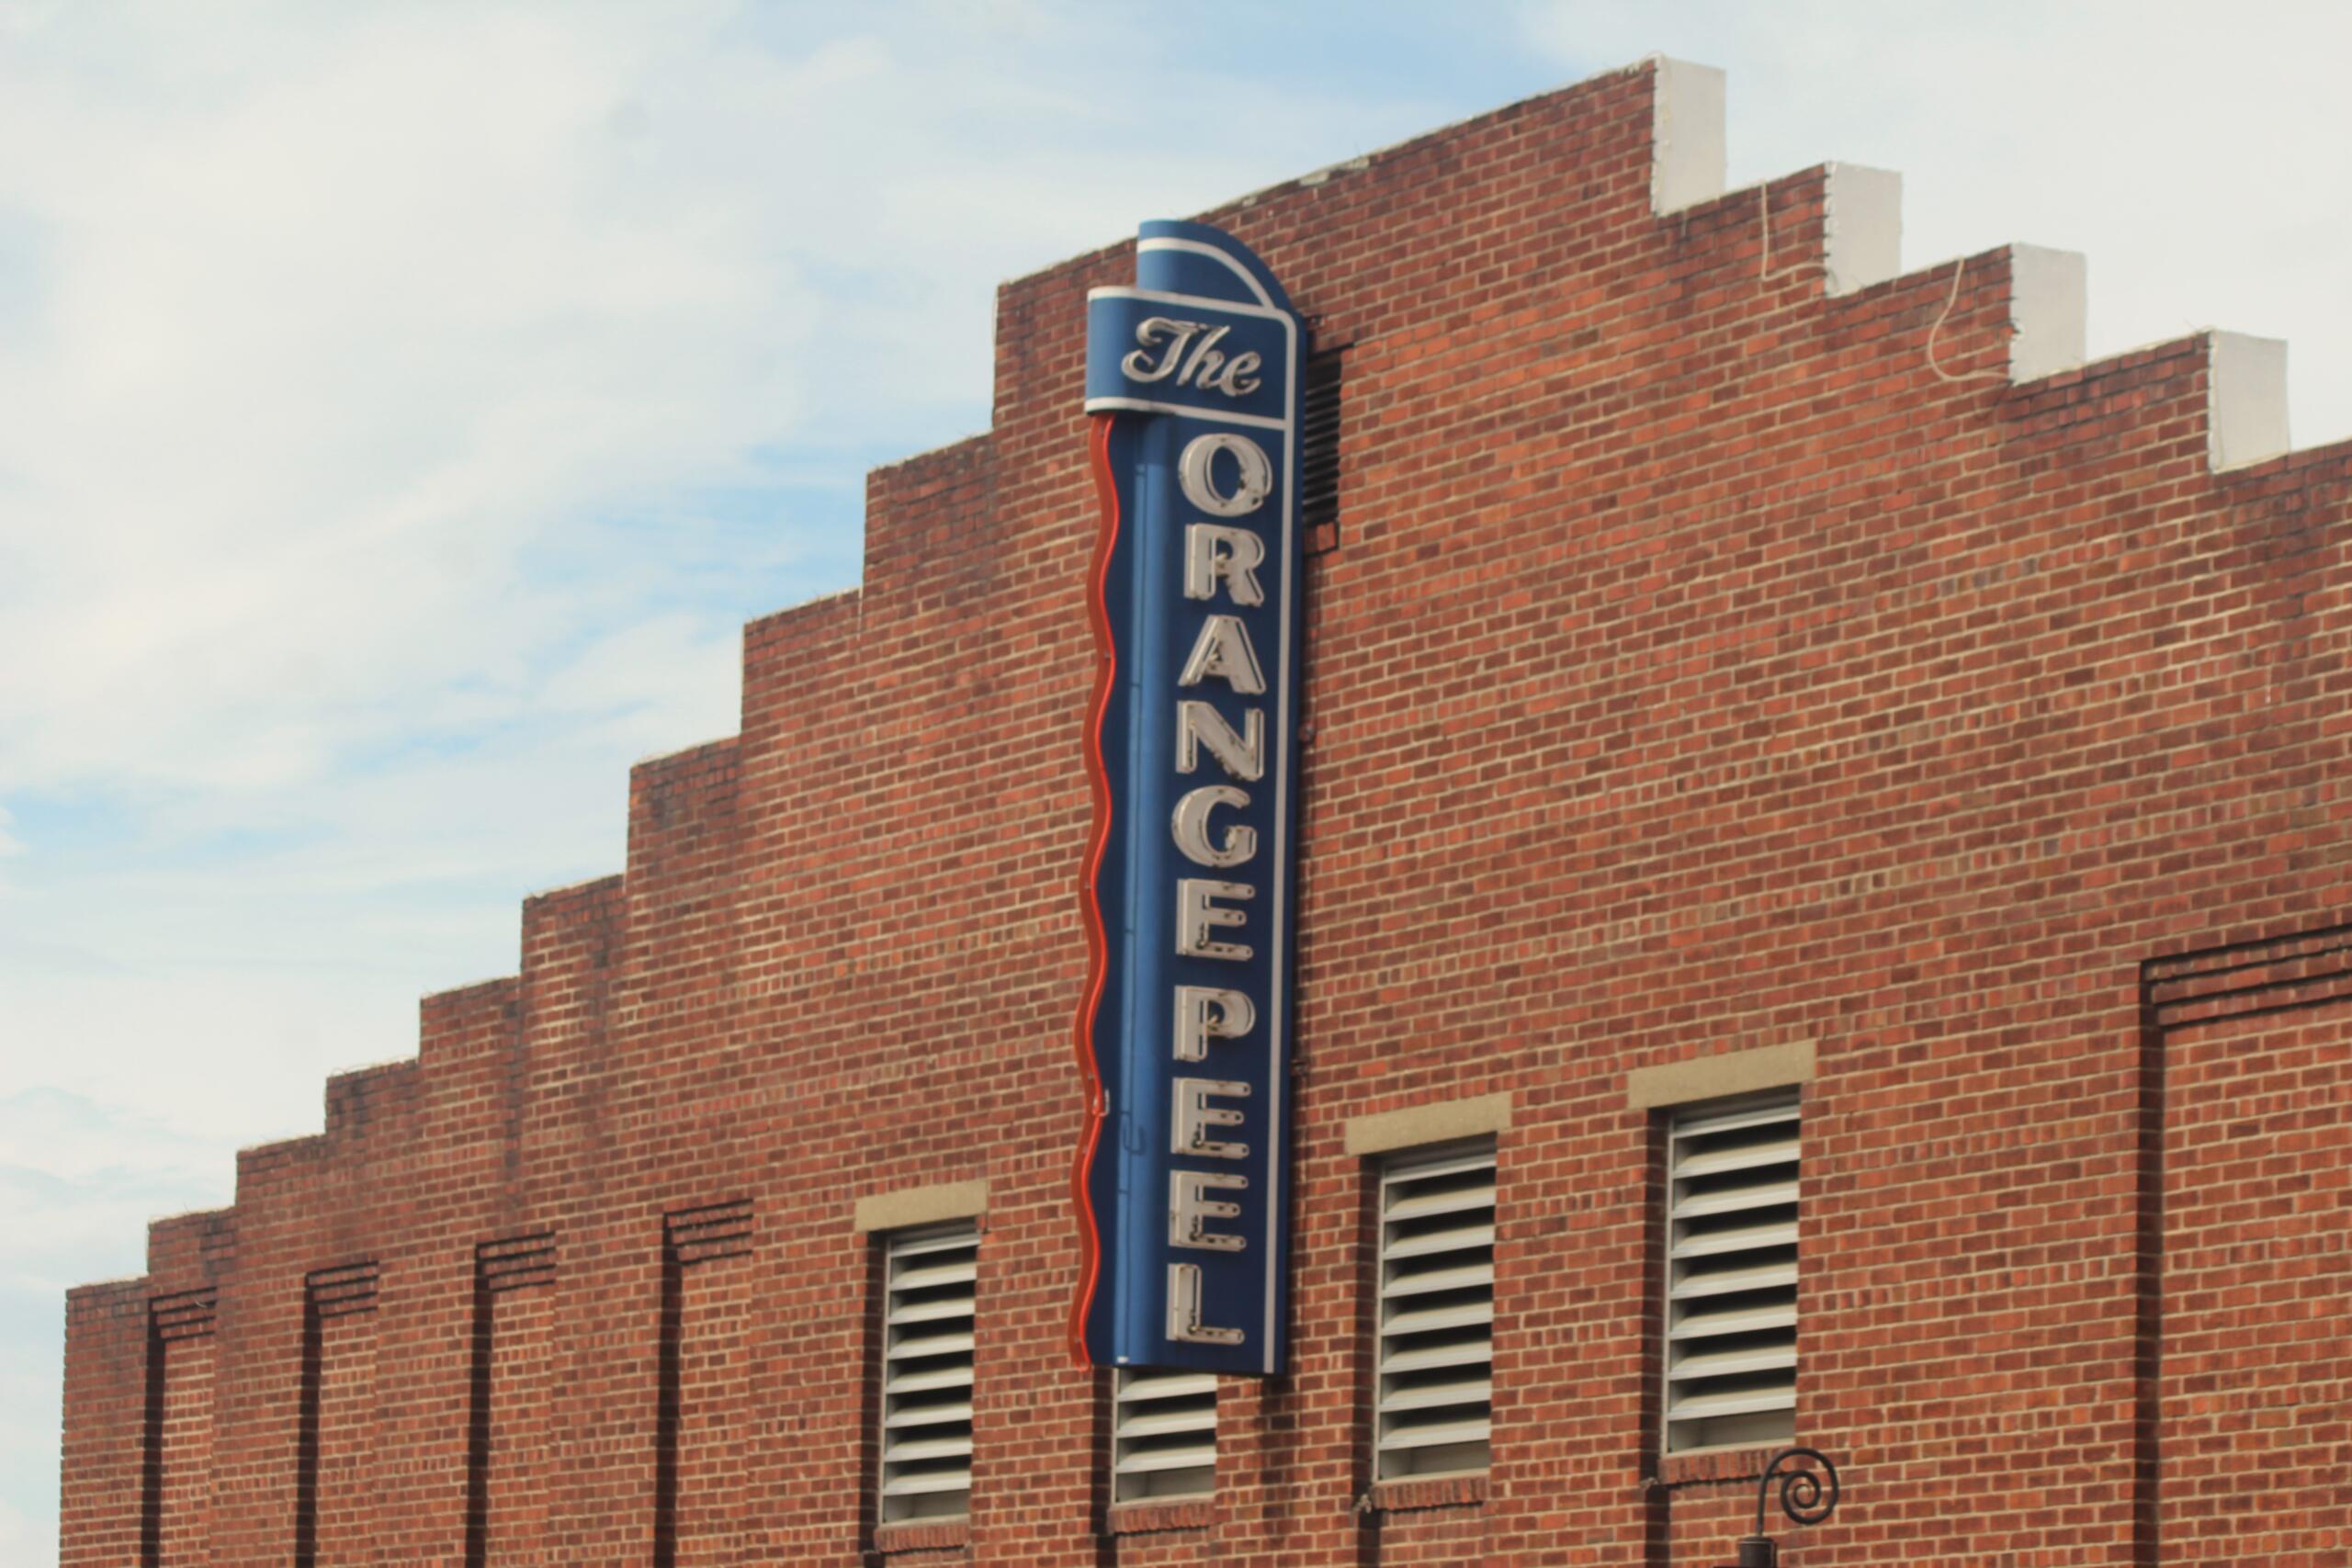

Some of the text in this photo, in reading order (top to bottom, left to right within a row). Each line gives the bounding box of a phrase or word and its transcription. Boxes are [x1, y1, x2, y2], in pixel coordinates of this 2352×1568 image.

[1121, 316, 1261, 397] The
[1165, 433, 1273, 1346] ORANGE PEEL
